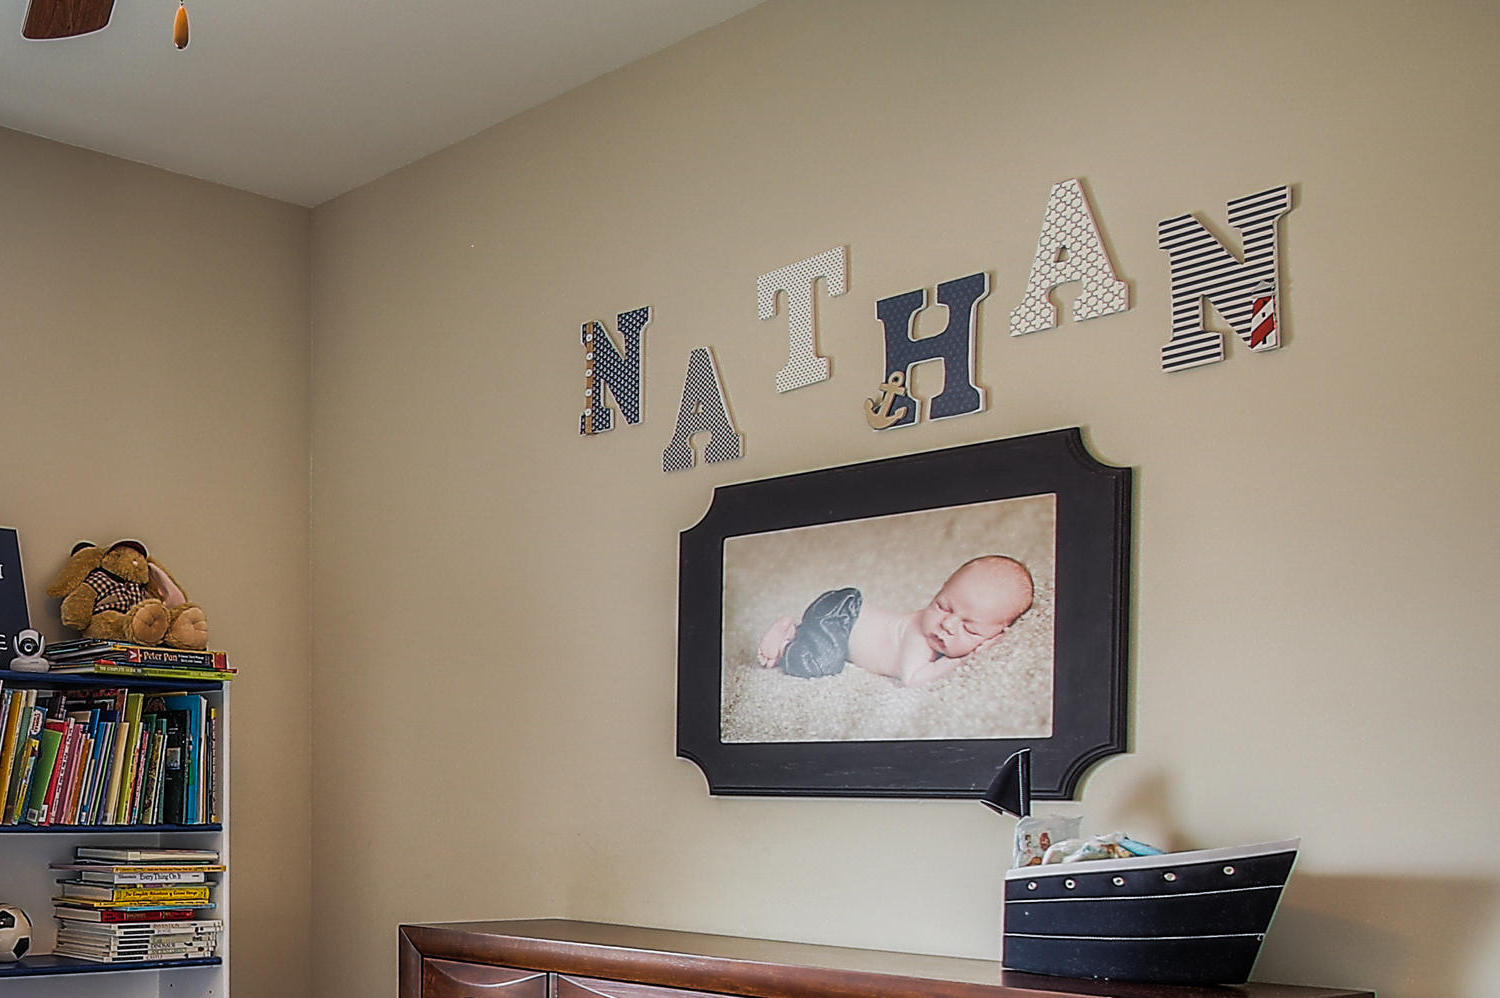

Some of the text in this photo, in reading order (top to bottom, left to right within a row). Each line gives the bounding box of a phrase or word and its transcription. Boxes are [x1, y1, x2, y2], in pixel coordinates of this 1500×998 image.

[580, 177, 1293, 474] NATHAN
[143, 651, 162, 661] Peter
[163, 652, 178, 662] Pan
